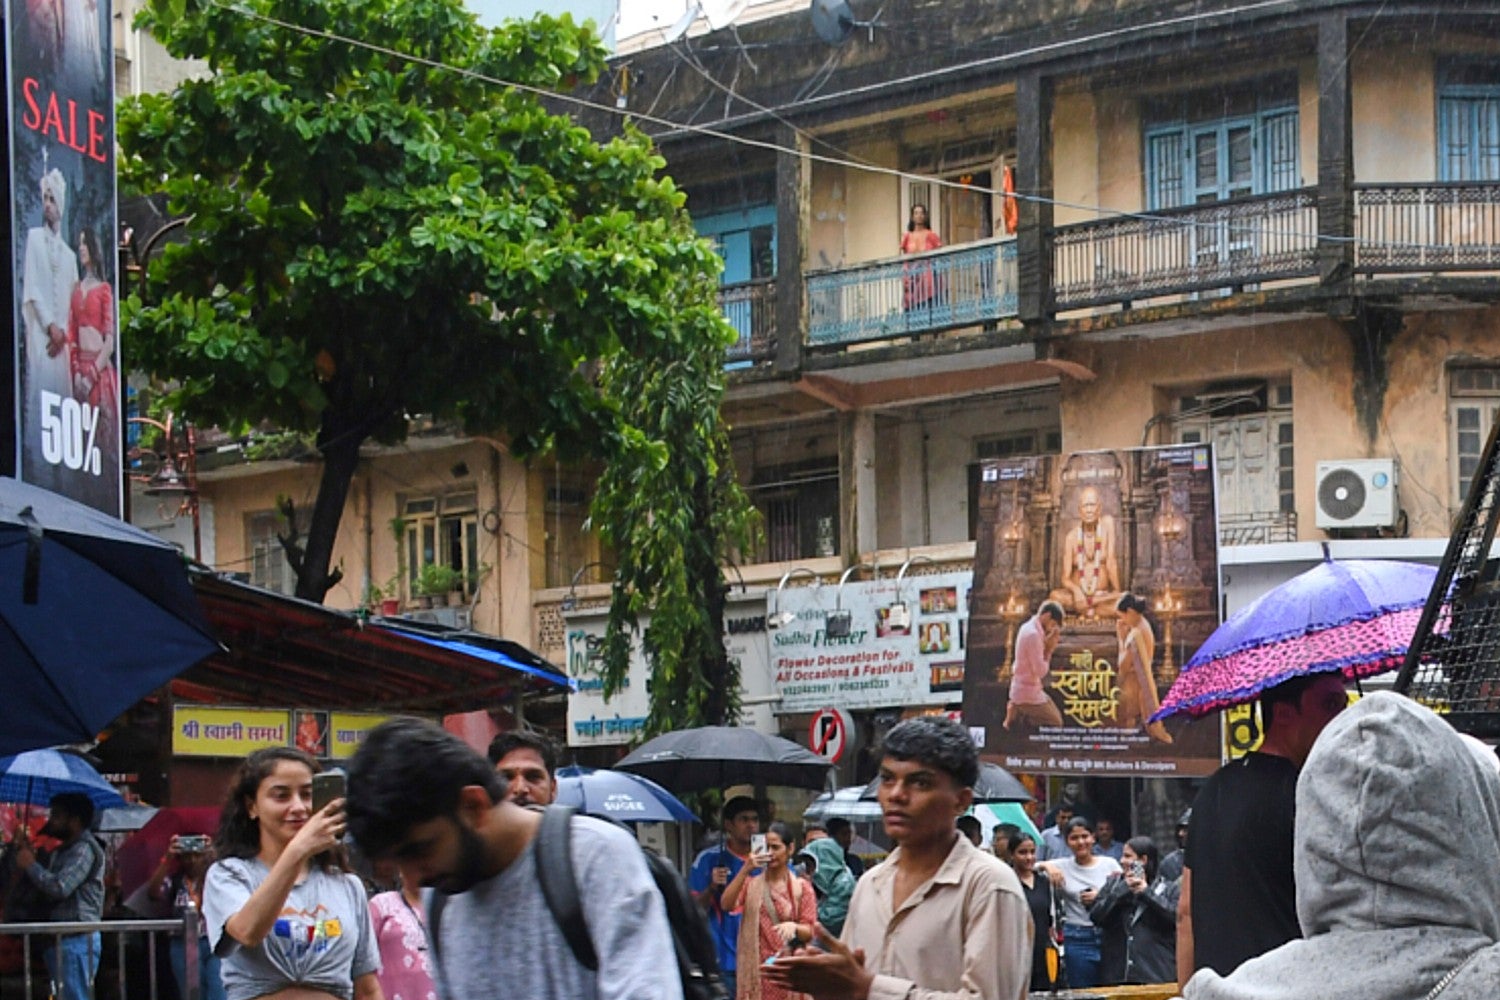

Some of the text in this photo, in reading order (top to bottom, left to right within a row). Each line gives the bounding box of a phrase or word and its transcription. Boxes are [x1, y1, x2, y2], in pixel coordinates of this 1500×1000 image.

[23, 77, 107, 162] SALE
[40, 389, 101, 477] 50%
[776, 661, 914, 682] All Occasions & Festivals
[778, 649, 900, 668] Flower Decoration for
[1051, 658, 1116, 698] स्वामी
[1064, 687, 1121, 727] समर्थ
[182, 719, 285, 742] श्री स्वामी समर्थ
[821, 716, 838, 755] P
